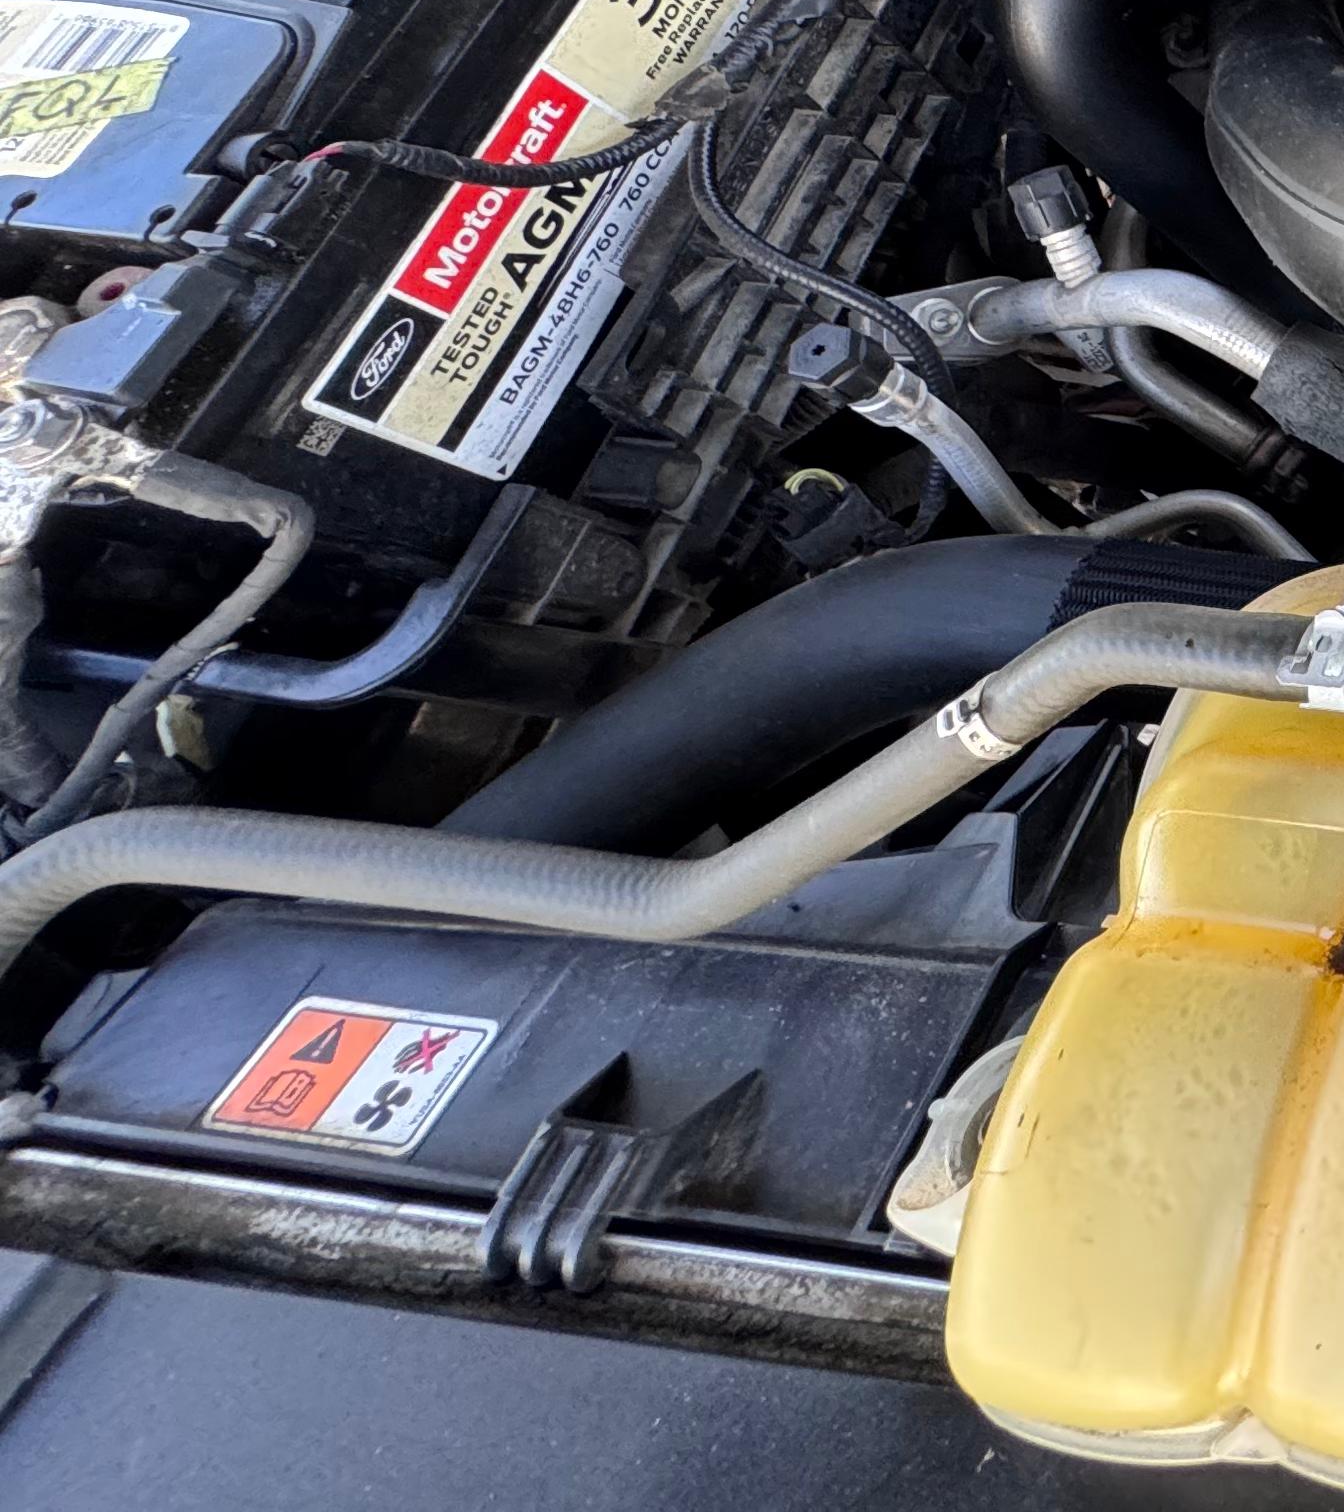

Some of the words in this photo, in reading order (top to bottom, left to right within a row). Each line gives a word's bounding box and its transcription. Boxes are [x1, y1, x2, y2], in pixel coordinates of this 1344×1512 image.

[645, 43, 674, 80] Free
[417, 93, 567, 289] Motoraft
[491, 156, 599, 292] AGM
[430, 285, 500, 379] TESTED
[496, 220, 623, 405] BAGM-48H6-760
[617, 170, 652, 213] 760
[353, 328, 409, 388] Ford
